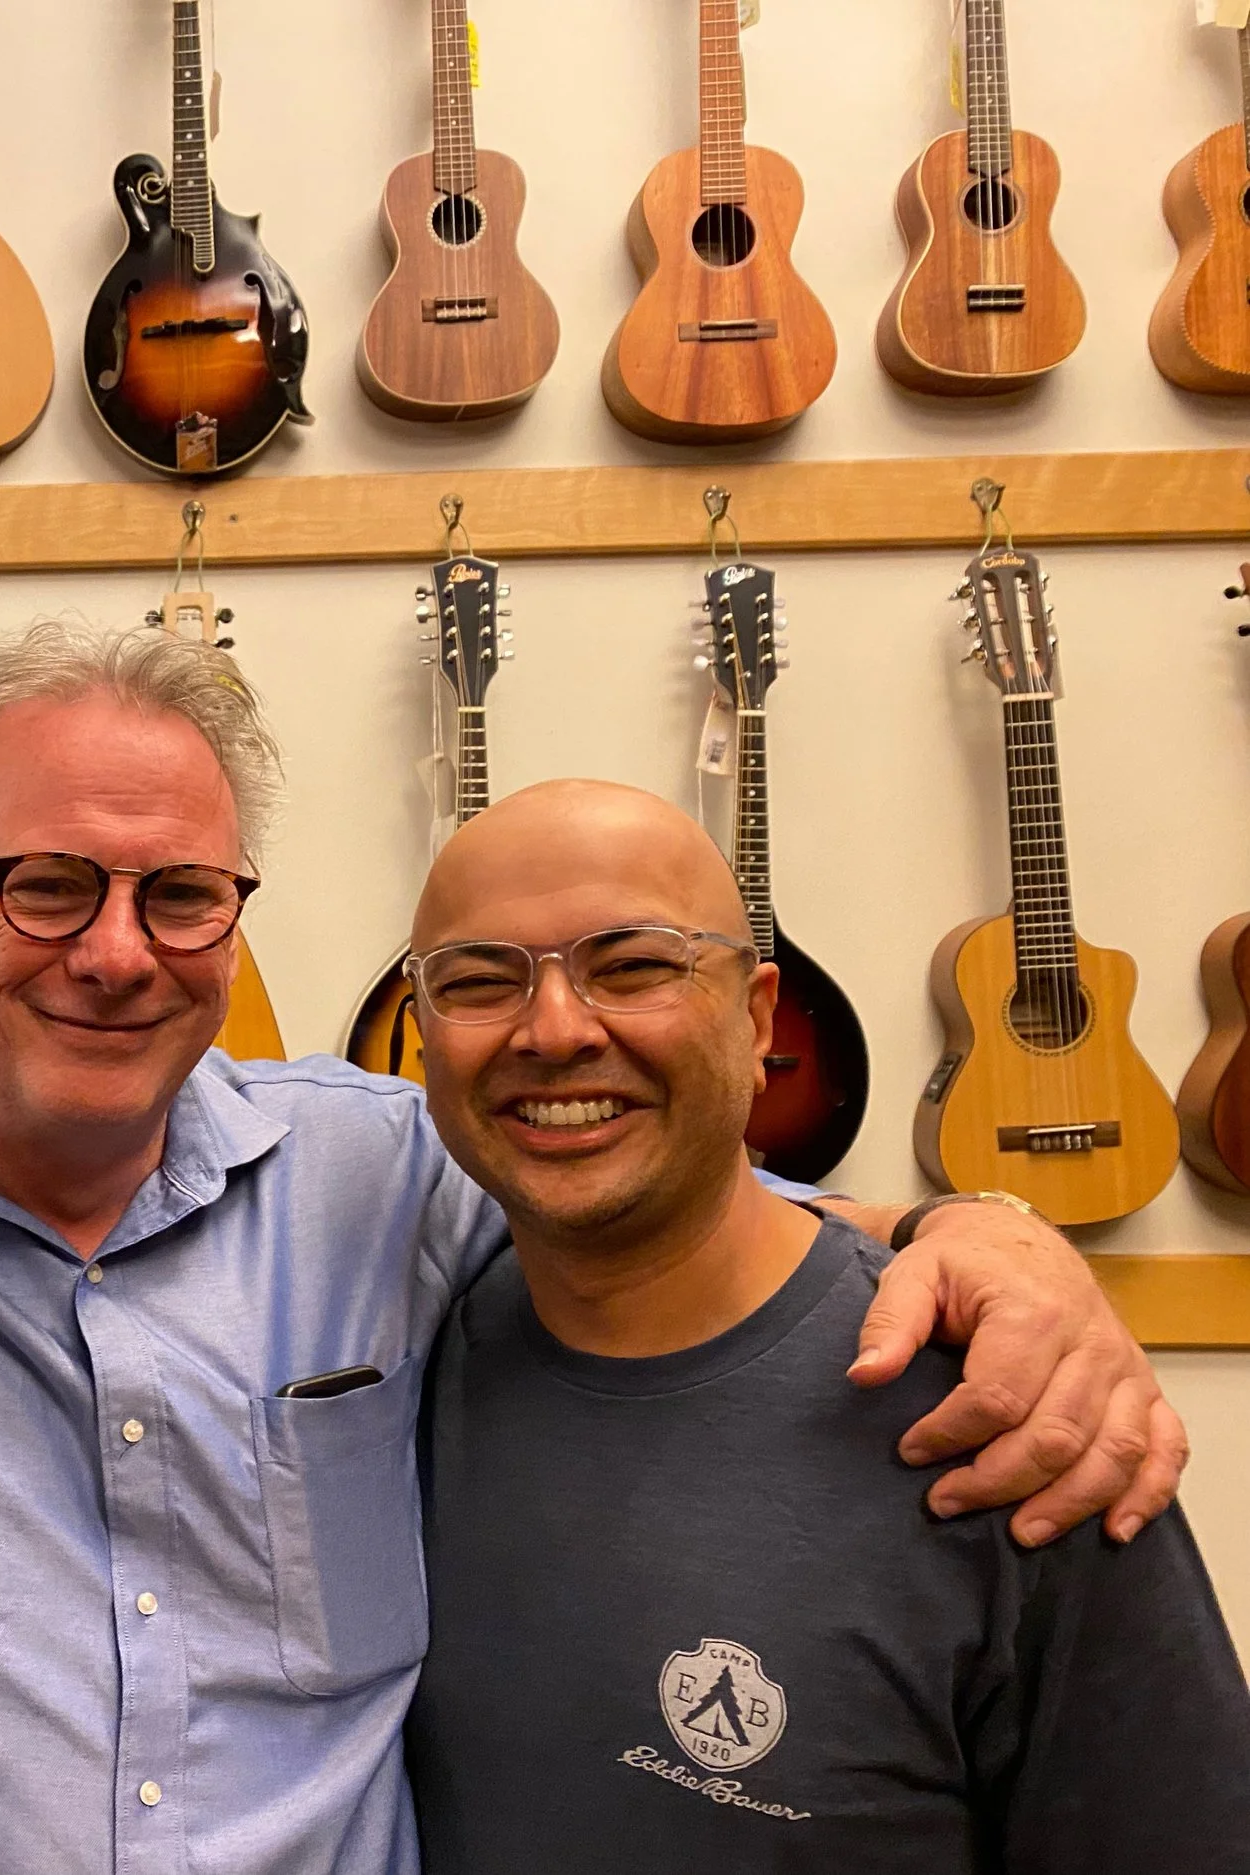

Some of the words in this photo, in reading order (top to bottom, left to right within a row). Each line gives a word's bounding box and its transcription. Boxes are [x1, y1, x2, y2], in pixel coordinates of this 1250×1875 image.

[710, 1649, 751, 1667] CAMP
[674, 1672, 697, 1704] E
[746, 1697, 769, 1727] B
[693, 1738, 730, 1762] 1920
[617, 1746, 703, 1790] Eddie
[702, 1778, 811, 1821] Bauer
